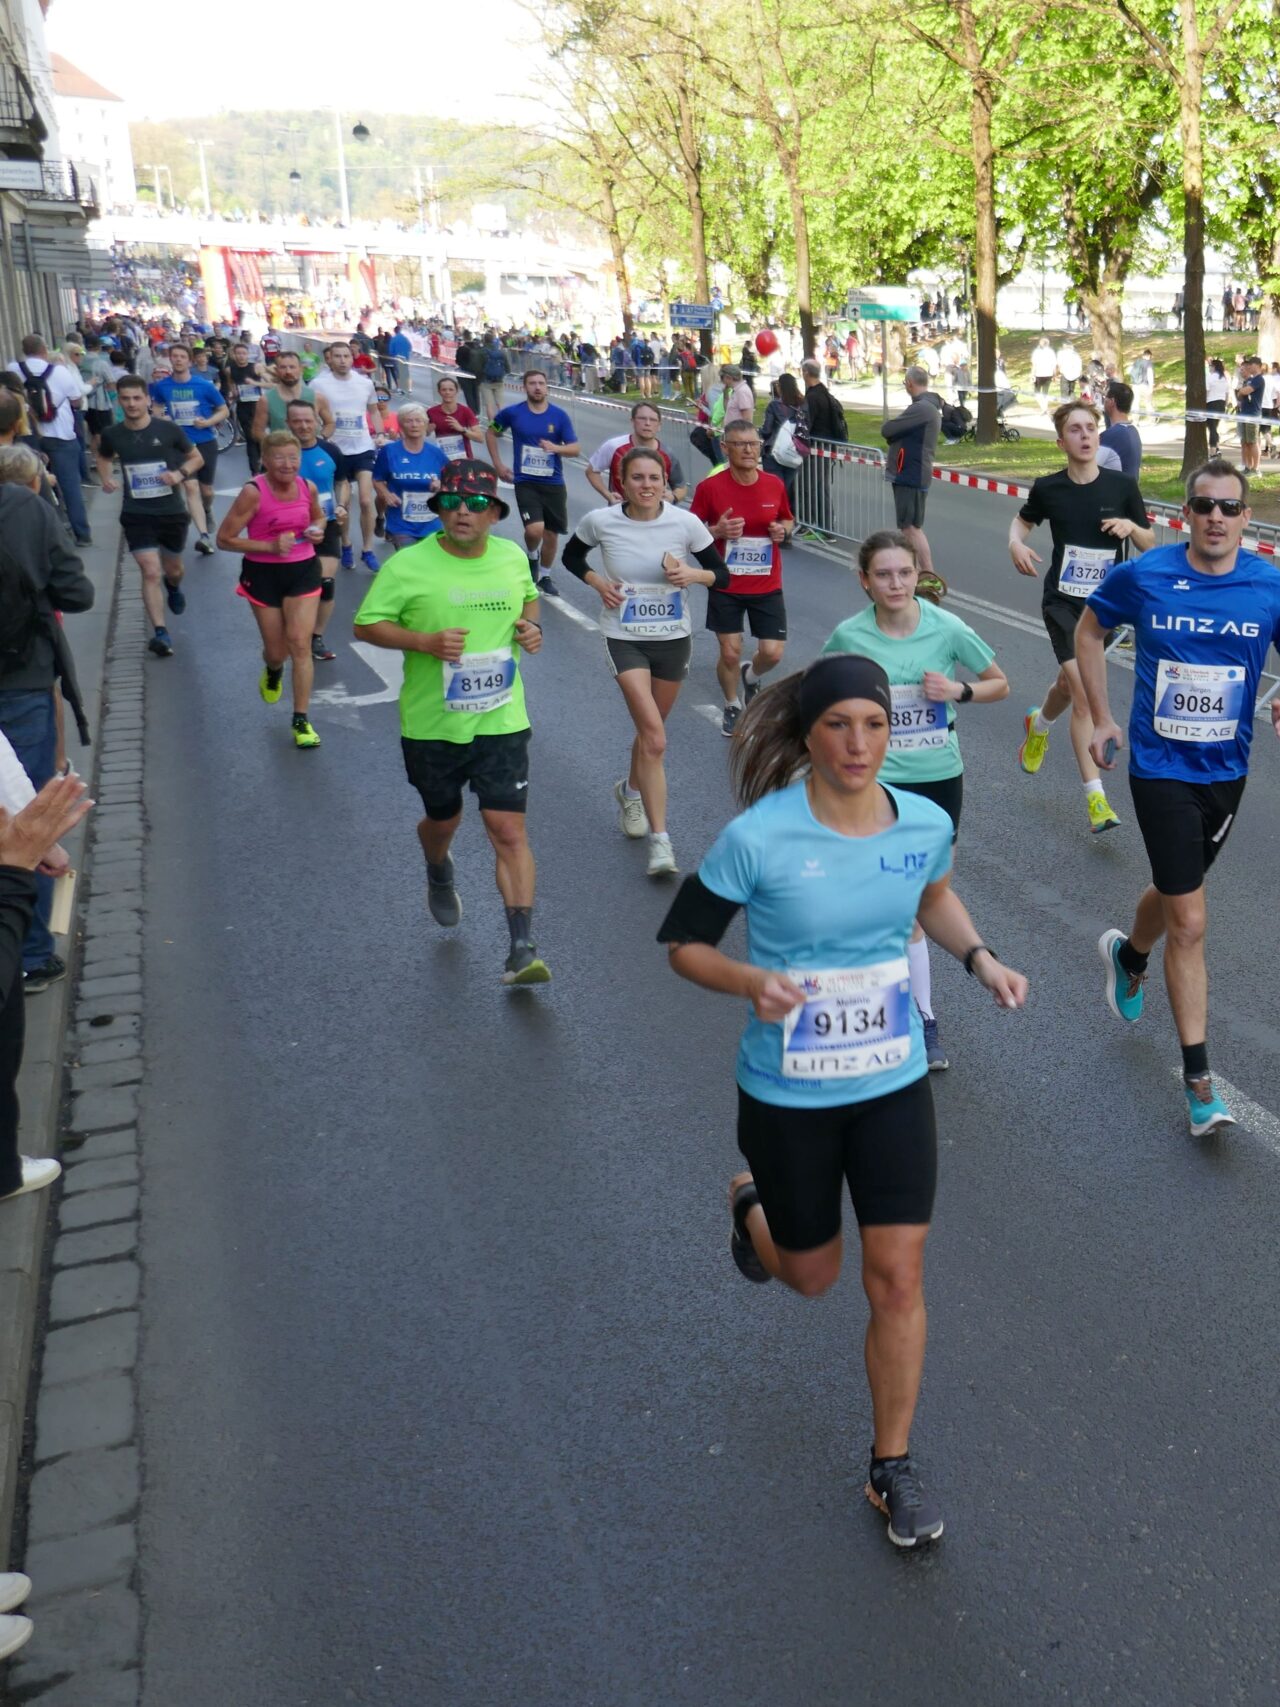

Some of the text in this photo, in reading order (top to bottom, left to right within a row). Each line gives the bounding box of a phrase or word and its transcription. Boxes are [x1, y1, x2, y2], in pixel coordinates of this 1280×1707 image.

[411, 503, 430, 512] 909
[733, 551, 767, 562] 11320
[1069, 565, 1107, 580] 13720
[630, 604, 675, 616] 10602
[1152, 614, 1260, 638] LINZ AG
[461, 673, 504, 692] 8149
[1173, 693, 1224, 713] 9084
[1160, 722, 1231, 737] LINZ AG
[889, 738, 914, 748] NZ
[814, 1005, 888, 1037] 9134
[792, 1048, 902, 1073] LINZ AG
